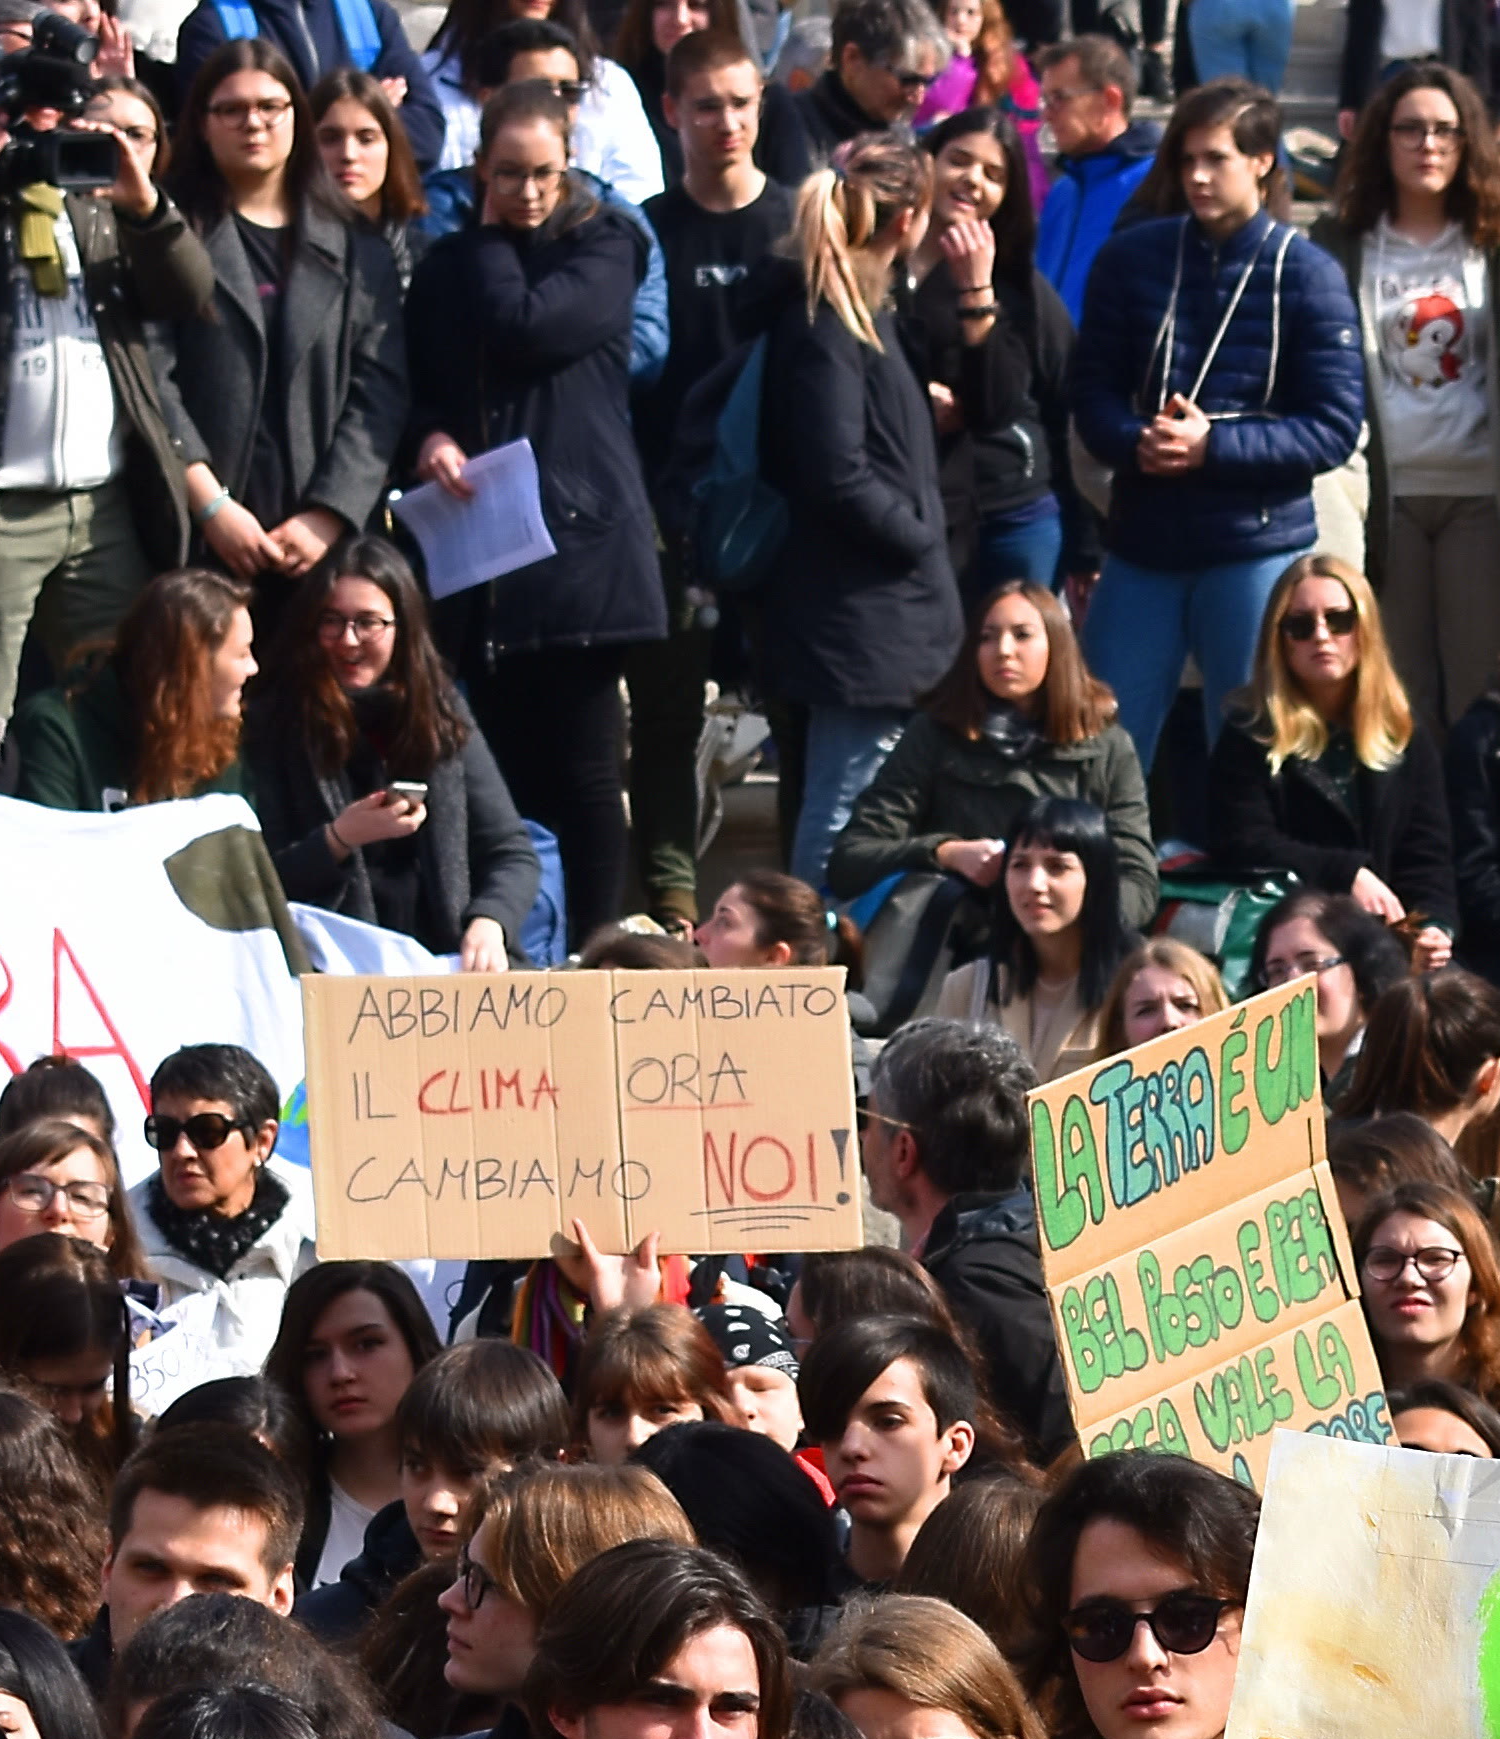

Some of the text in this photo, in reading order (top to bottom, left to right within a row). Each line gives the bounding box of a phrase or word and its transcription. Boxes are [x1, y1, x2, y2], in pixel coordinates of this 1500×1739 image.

[349, 984, 838, 1044] ABBIAMO CAMBIATO
[352, 1052, 748, 1121] IL CLIMA ORA
[1030, 1094, 1105, 1250] LA
[1089, 1046, 1215, 1210] TERRA
[1254, 987, 1316, 1126] UN
[346, 1156, 653, 1202] CAMBIAMO
[1060, 1272, 1149, 1394] BEL
[1238, 1220, 1279, 1324] E
[1264, 1187, 1338, 1309] PER
[1194, 1346, 1294, 1453] VALE
[1294, 1321, 1356, 1409] LA
